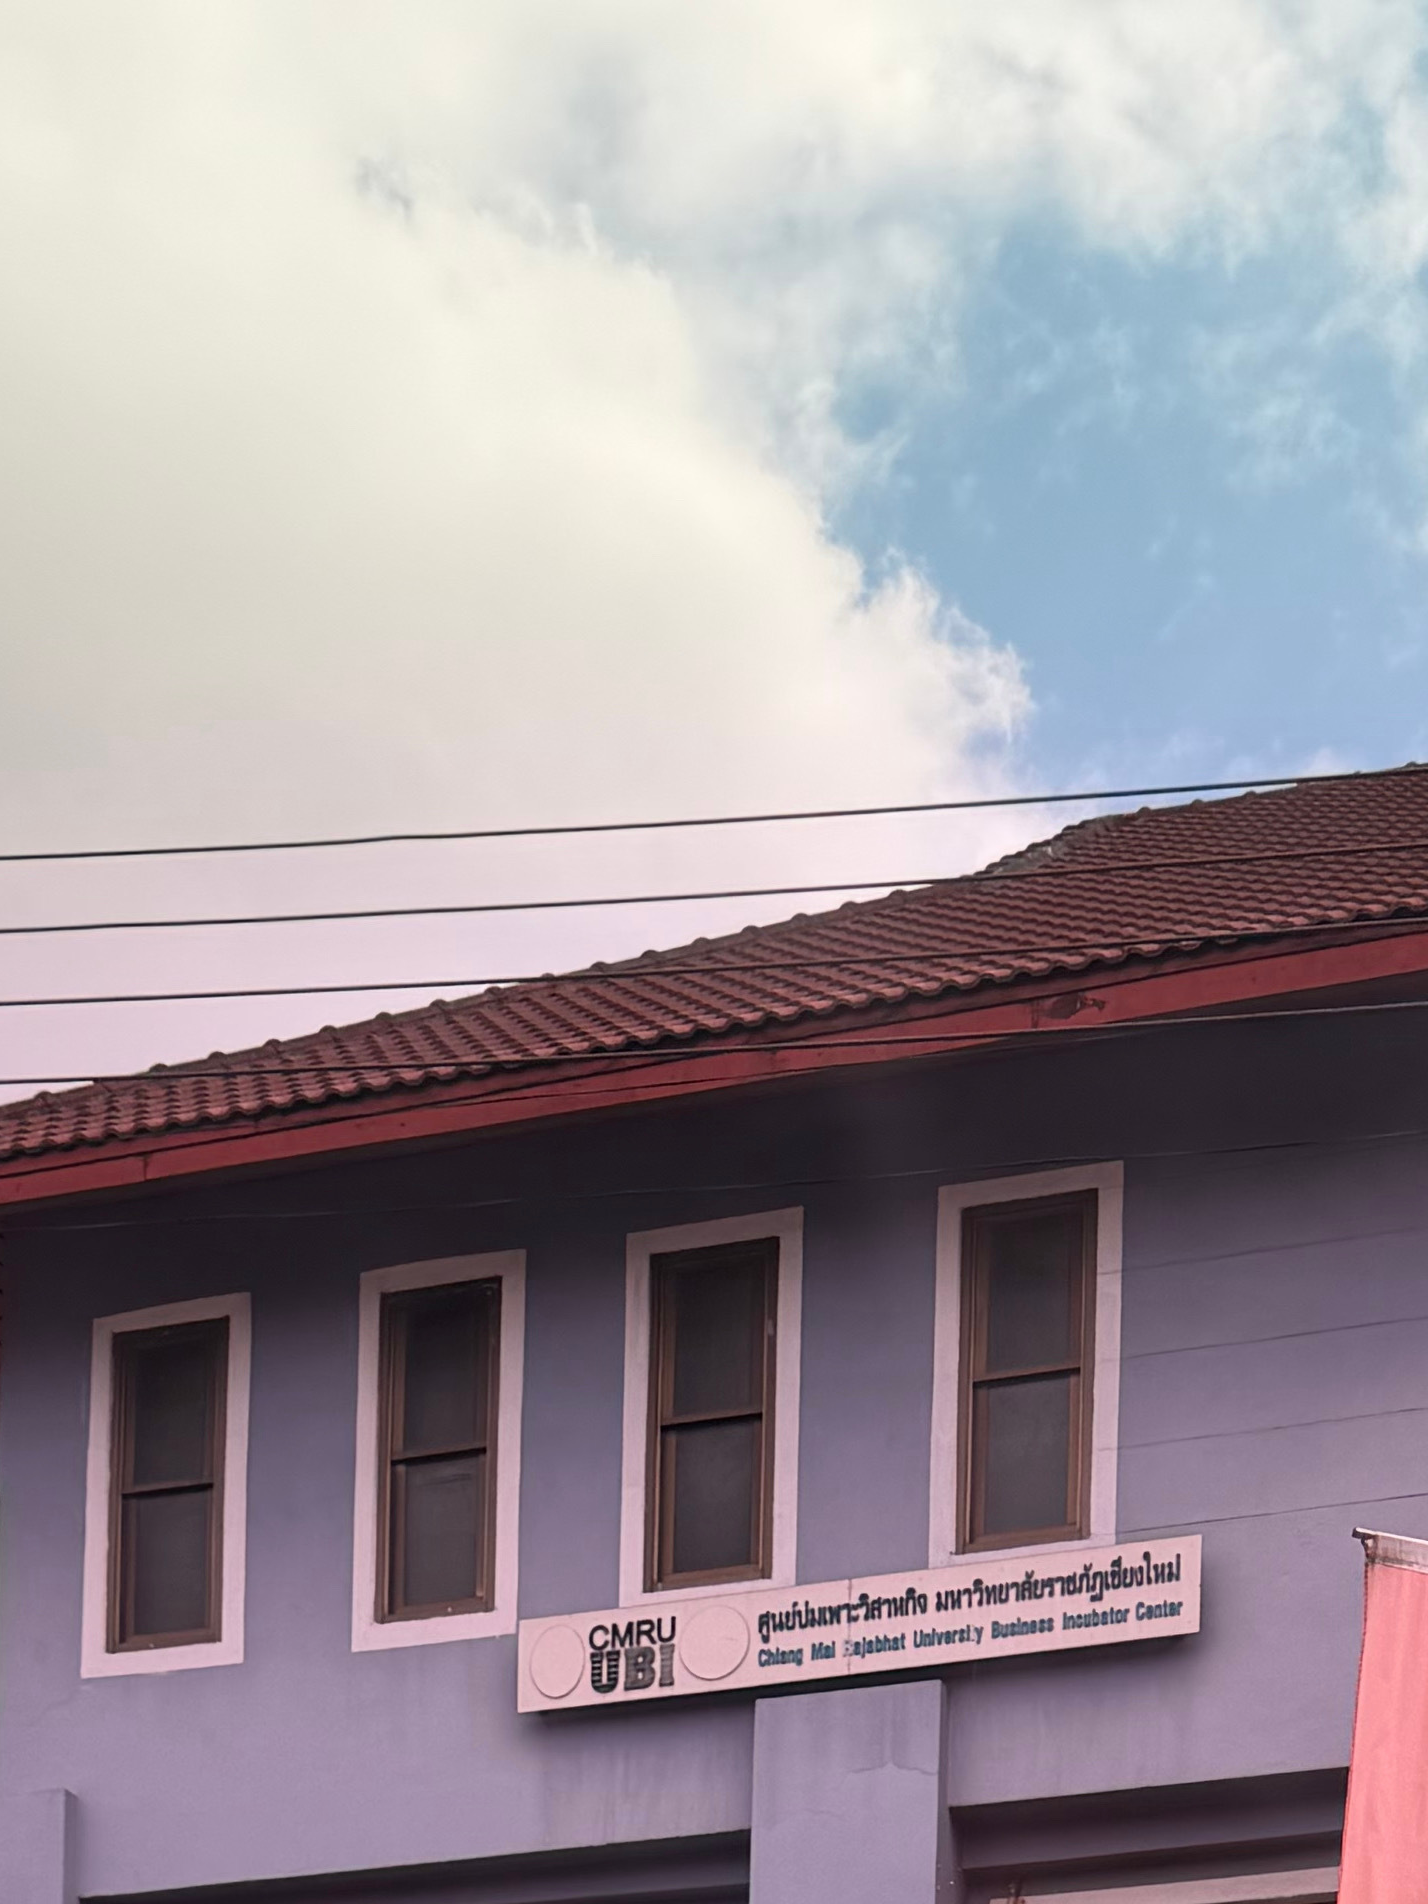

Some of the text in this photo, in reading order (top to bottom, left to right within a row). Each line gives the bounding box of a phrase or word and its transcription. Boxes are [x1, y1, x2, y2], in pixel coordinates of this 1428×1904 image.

[589, 1616, 676, 1651] CMRU
[758, 1647, 803, 1667] Chiang
[811, 1641, 836, 1661] Mai
[913, 1624, 984, 1649] Universiy
[991, 1616, 1054, 1640] Business
[1062, 1607, 1130, 1630] Incubator
[1135, 1600, 1183, 1621] Center
[590, 1643, 675, 1693] UBI
